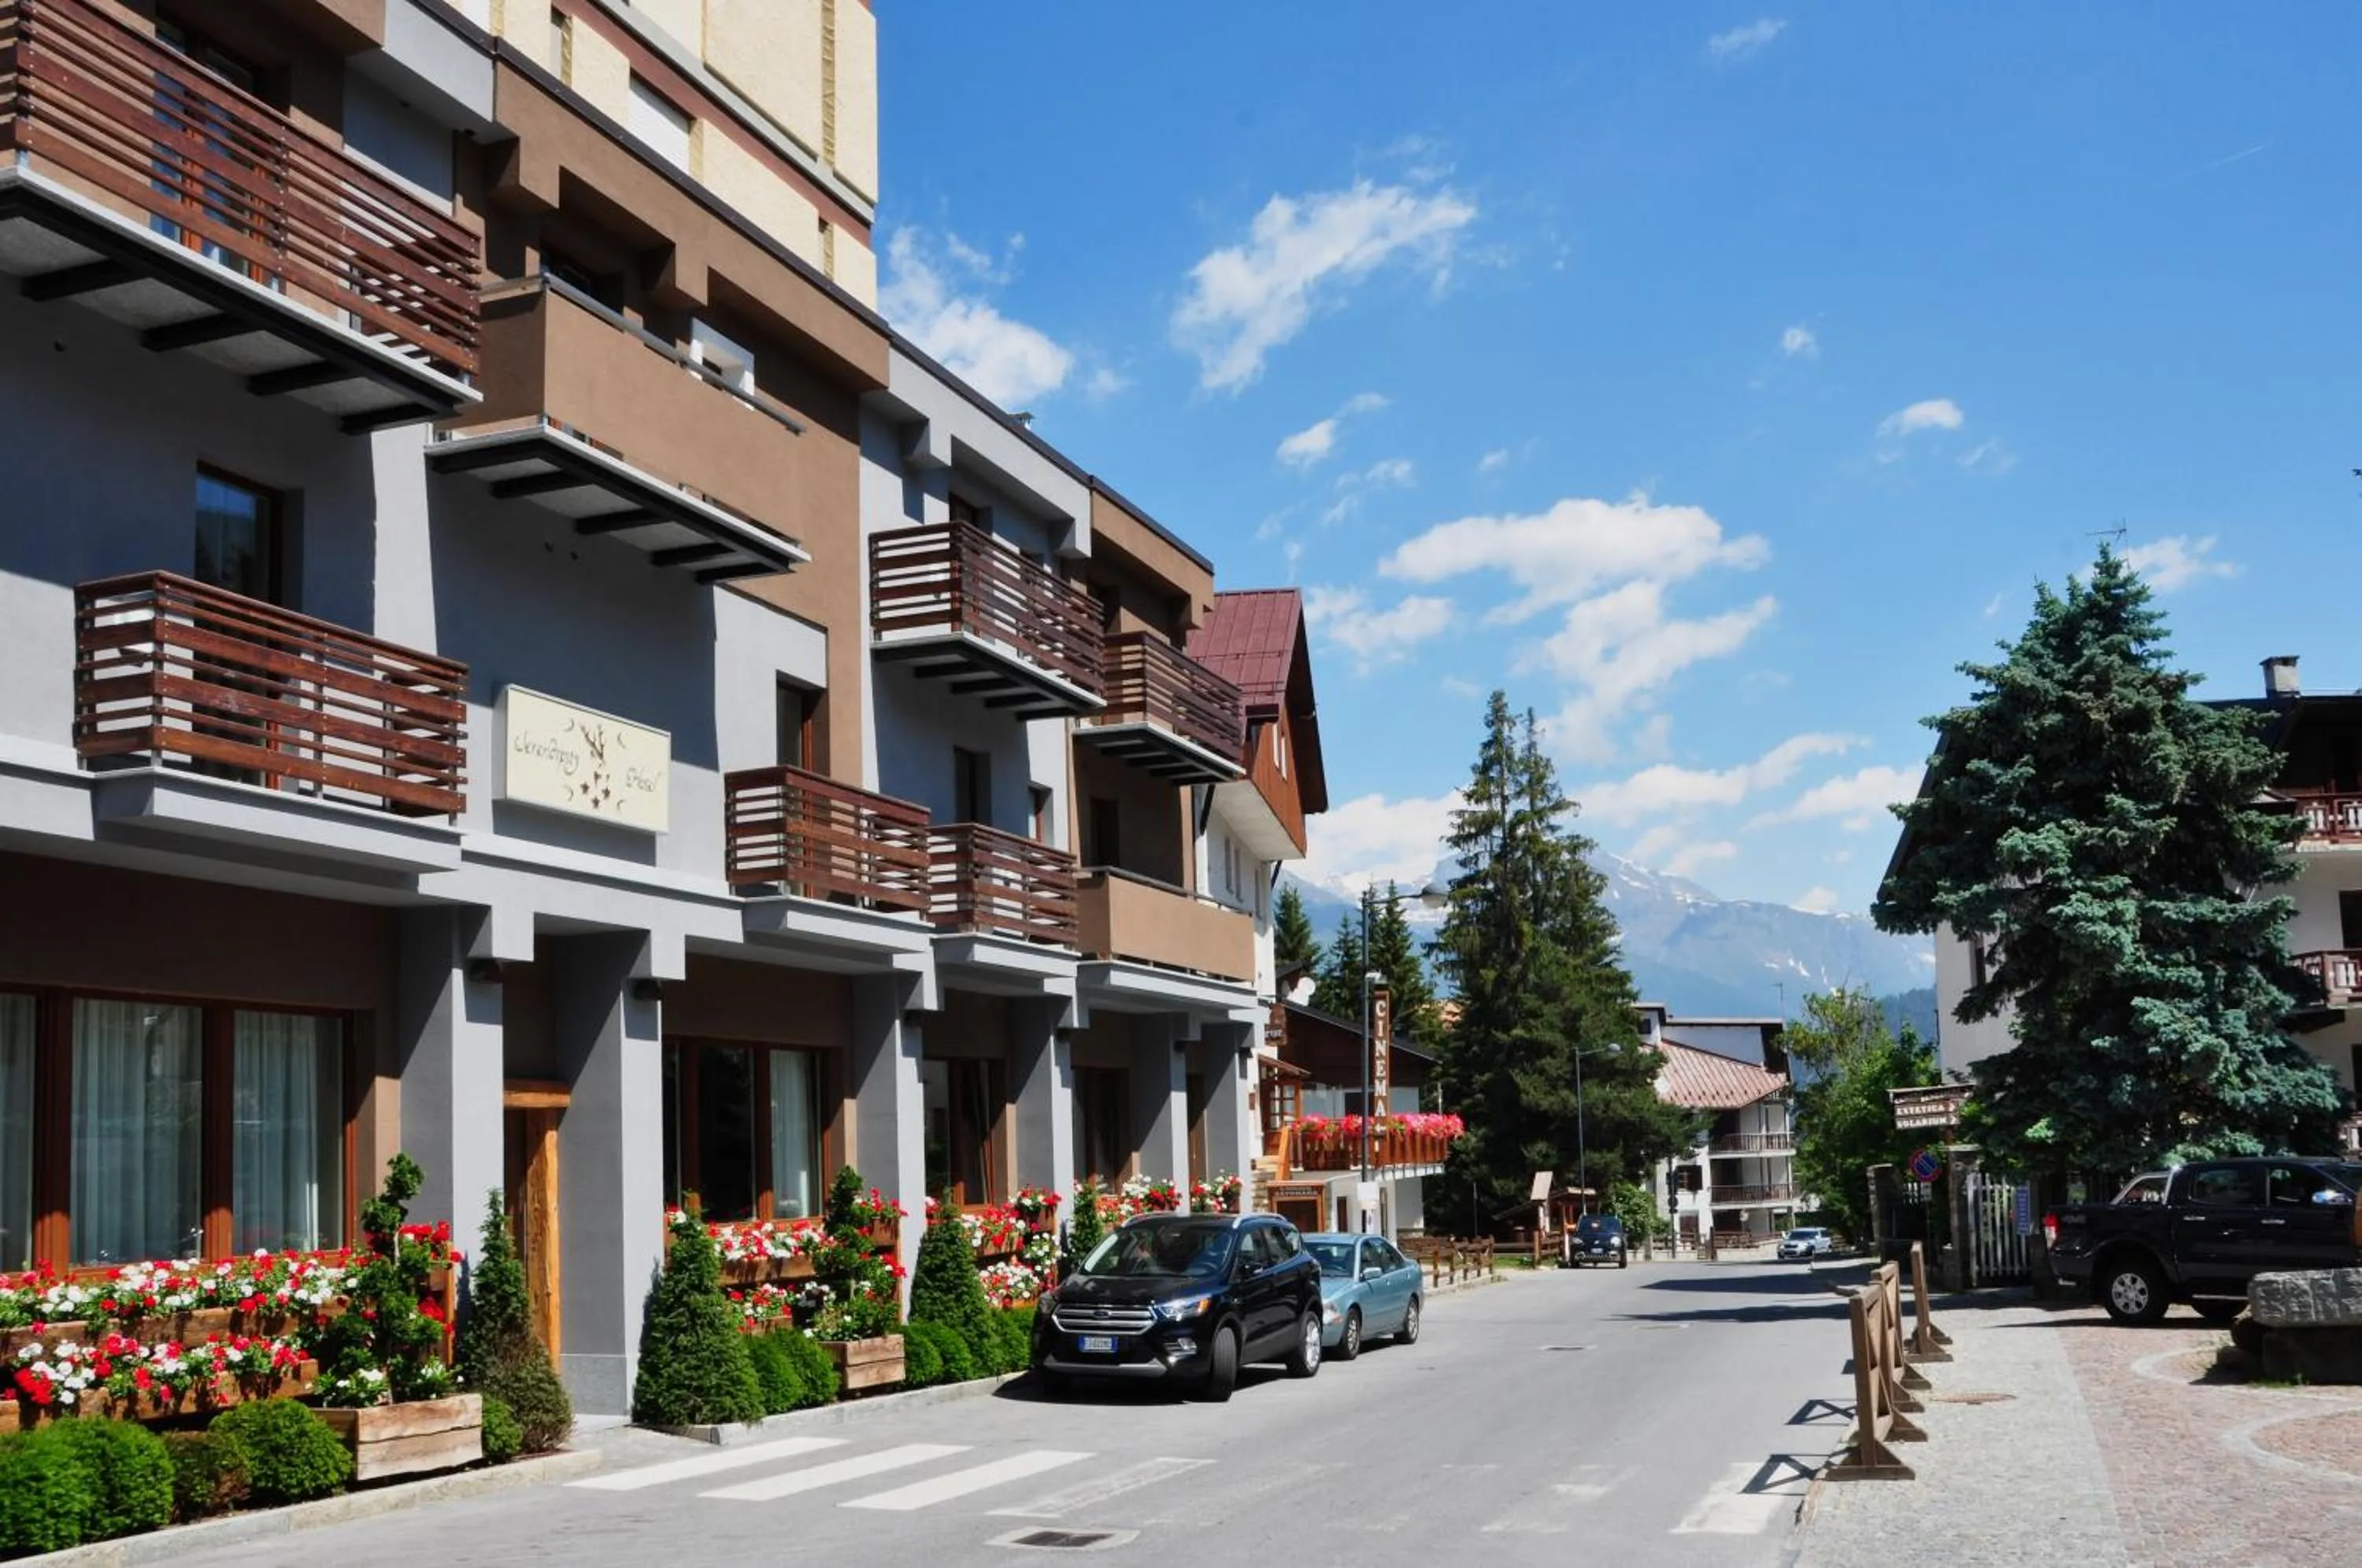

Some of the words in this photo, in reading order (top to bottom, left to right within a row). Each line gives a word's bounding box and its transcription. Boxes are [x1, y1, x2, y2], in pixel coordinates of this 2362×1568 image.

[1375, 1000, 1386, 1117] CINEMA
[1896, 1104, 1945, 1115] ESTETICA
[1896, 1117, 1947, 1128] SOLARIUM
